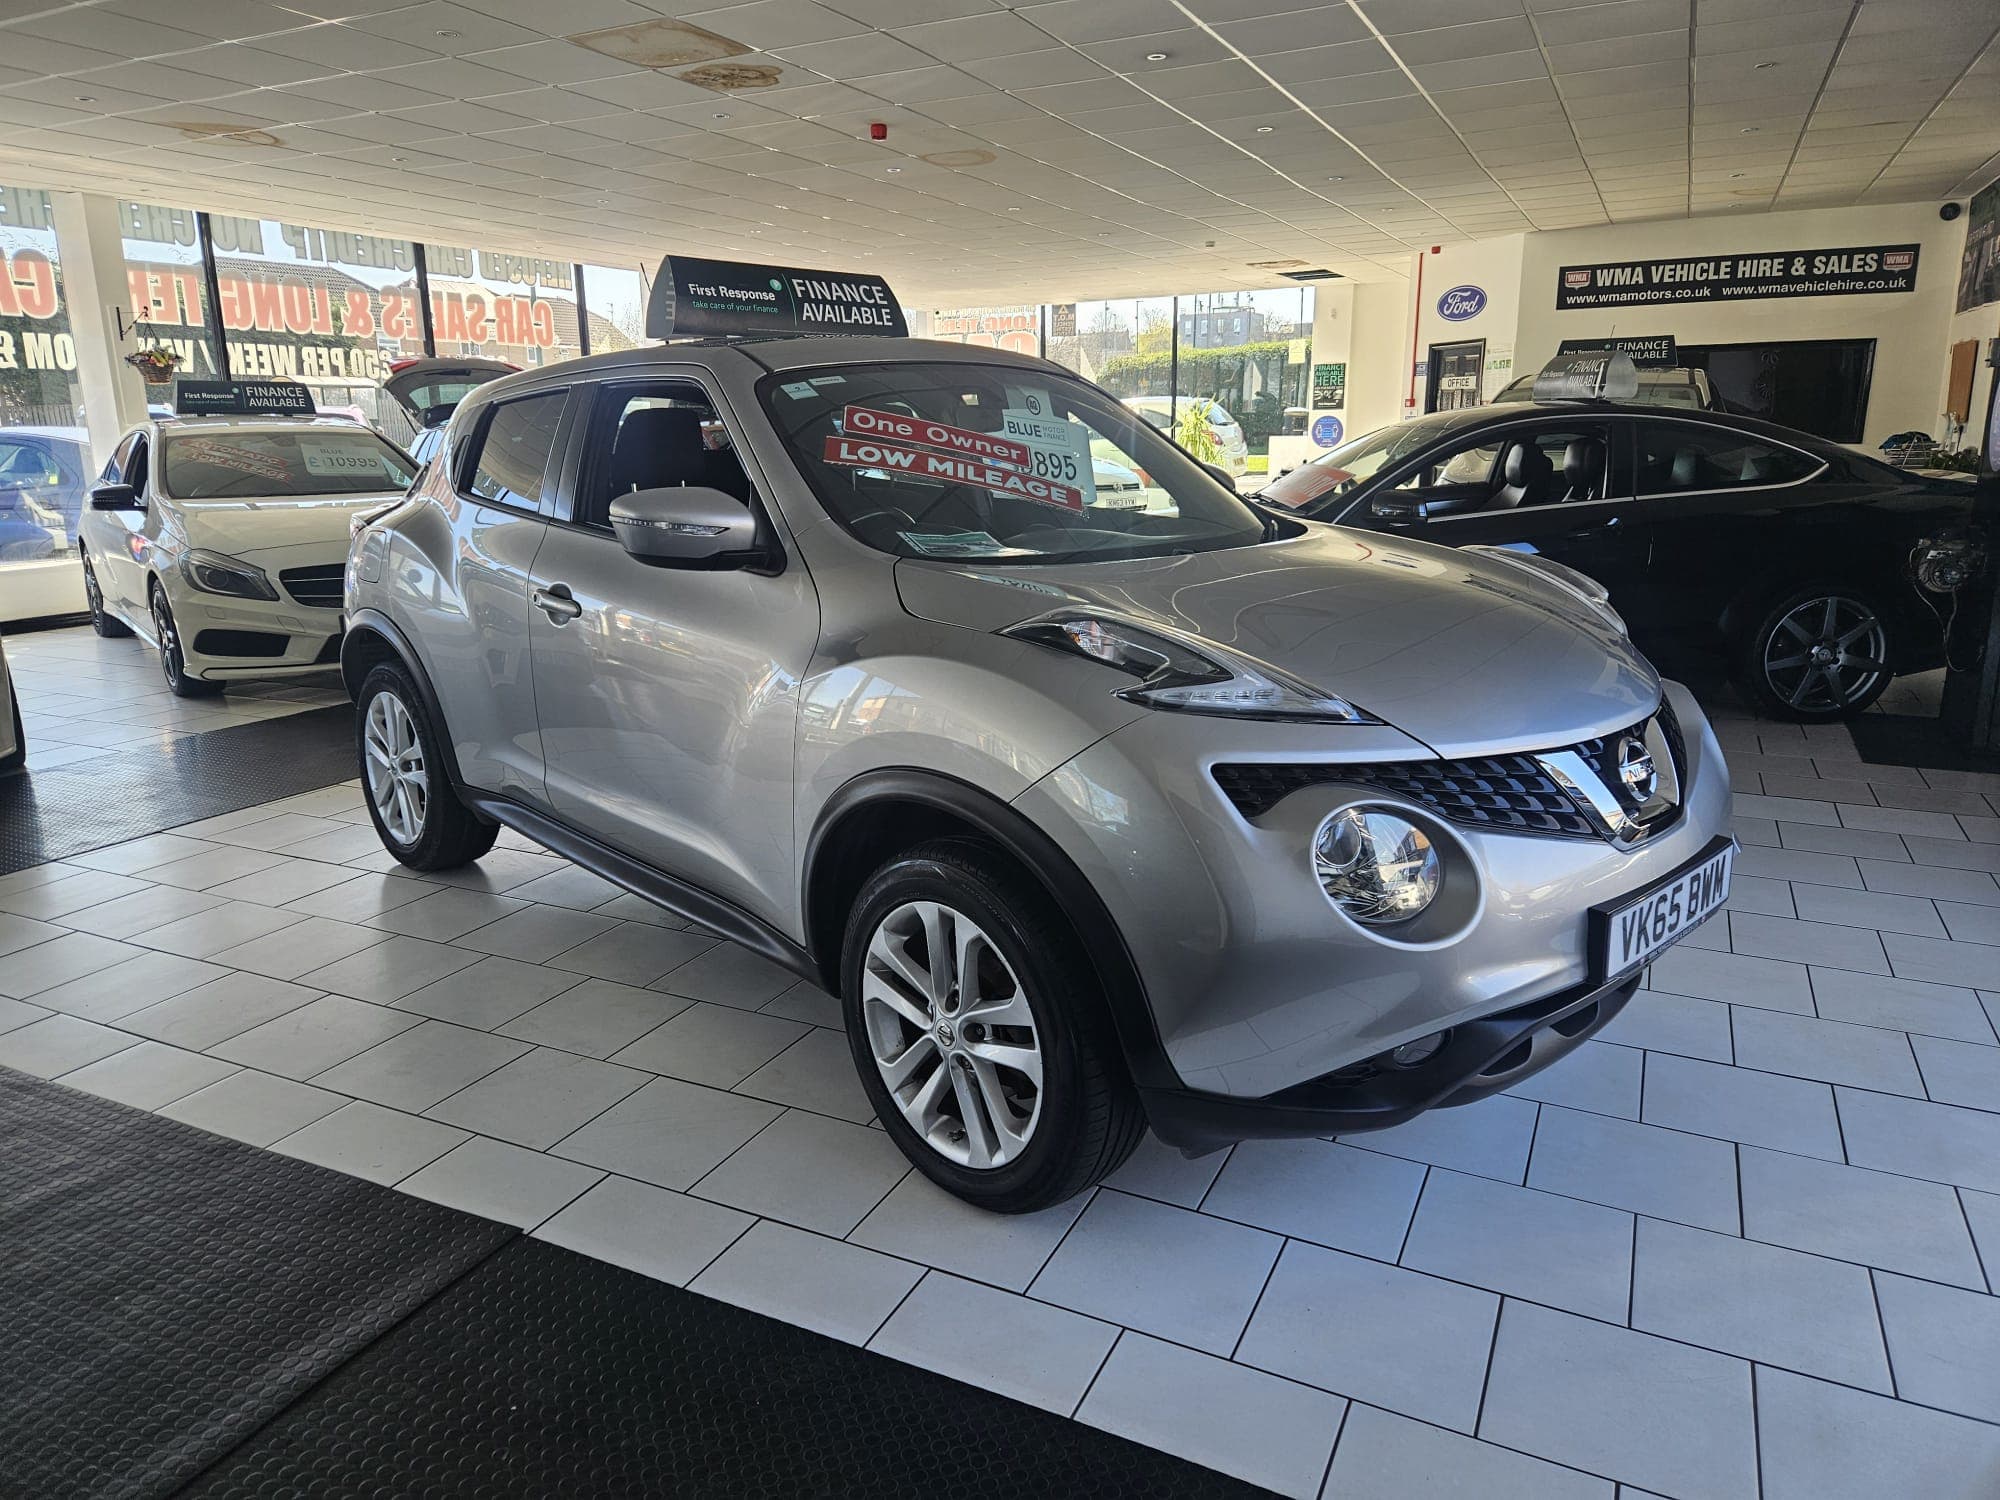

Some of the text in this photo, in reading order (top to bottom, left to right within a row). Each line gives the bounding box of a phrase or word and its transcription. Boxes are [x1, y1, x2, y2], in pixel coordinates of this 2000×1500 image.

[1886, 254, 1909, 265] WMA
[1567, 272, 1588, 283] WMA
[1596, 253, 1878, 287] WMA VEHICLE HIRE & SALES
[688, 283, 776, 301] First Response
[792, 278, 888, 305] FINANCE
[1566, 277, 1906, 304] www.wmamotors.co.uk www.wmavehiclehire.co.uk
[692, 300, 779, 314] take care of your finance
[1443, 291, 1480, 316] Ford
[802, 302, 893, 326] AVAILABLE
[1616, 340, 1669, 351] FINANCE
[1626, 350, 1668, 360] AILABLE
[1314, 375, 1344, 386] HERE
[1447, 377, 1469, 388] OFFICE
[202, 392, 234, 400] Response
[246, 386, 304, 397] FINANCE
[249, 397, 306, 407] AVAILABLE
[853, 411, 1020, 460] One Owner
[1007, 420, 1065, 438] BLUE MOTOR
[1043, 432, 1066, 441] FINANCE
[192, 440, 280, 466] AUTOMATIC
[191, 452, 287, 481] LOW MILEAGE
[839, 443, 1068, 504] LOW MILEAGE
[1024, 451, 1077, 481] 895
[1621, 883, 1683, 963] VK65
[1686, 854, 1727, 922] BWM
